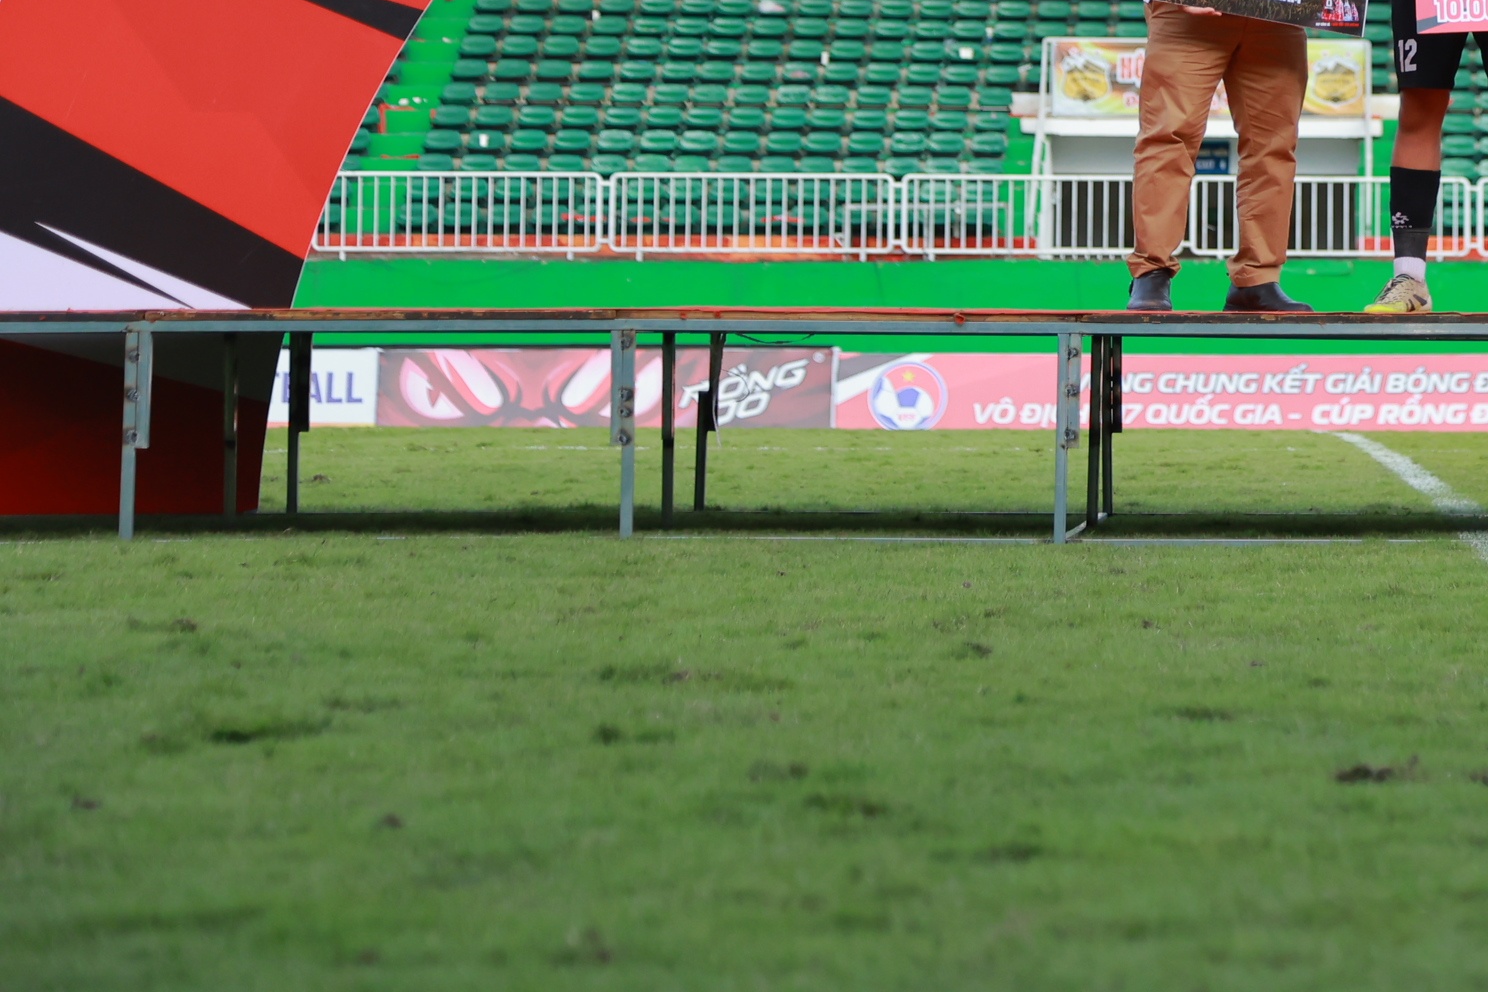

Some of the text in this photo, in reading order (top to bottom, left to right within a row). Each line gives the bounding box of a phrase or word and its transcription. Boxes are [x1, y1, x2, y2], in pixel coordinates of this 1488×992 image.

[1398, 39, 1417, 72] 12
[1157, 372, 1259, 394] CHUNG
[1263, 364, 1320, 394] KẾT
[1325, 366, 1382, 395] GIẢI
[1386, 366, 1471, 395] BÓNG
[973, 396, 1016, 424] VÔ
[1145, 394, 1230, 424] QUỐC
[1233, 403, 1284, 425] GIA
[1311, 397, 1375, 425] CÚP
[1377, 393, 1466, 425] RỒNG
